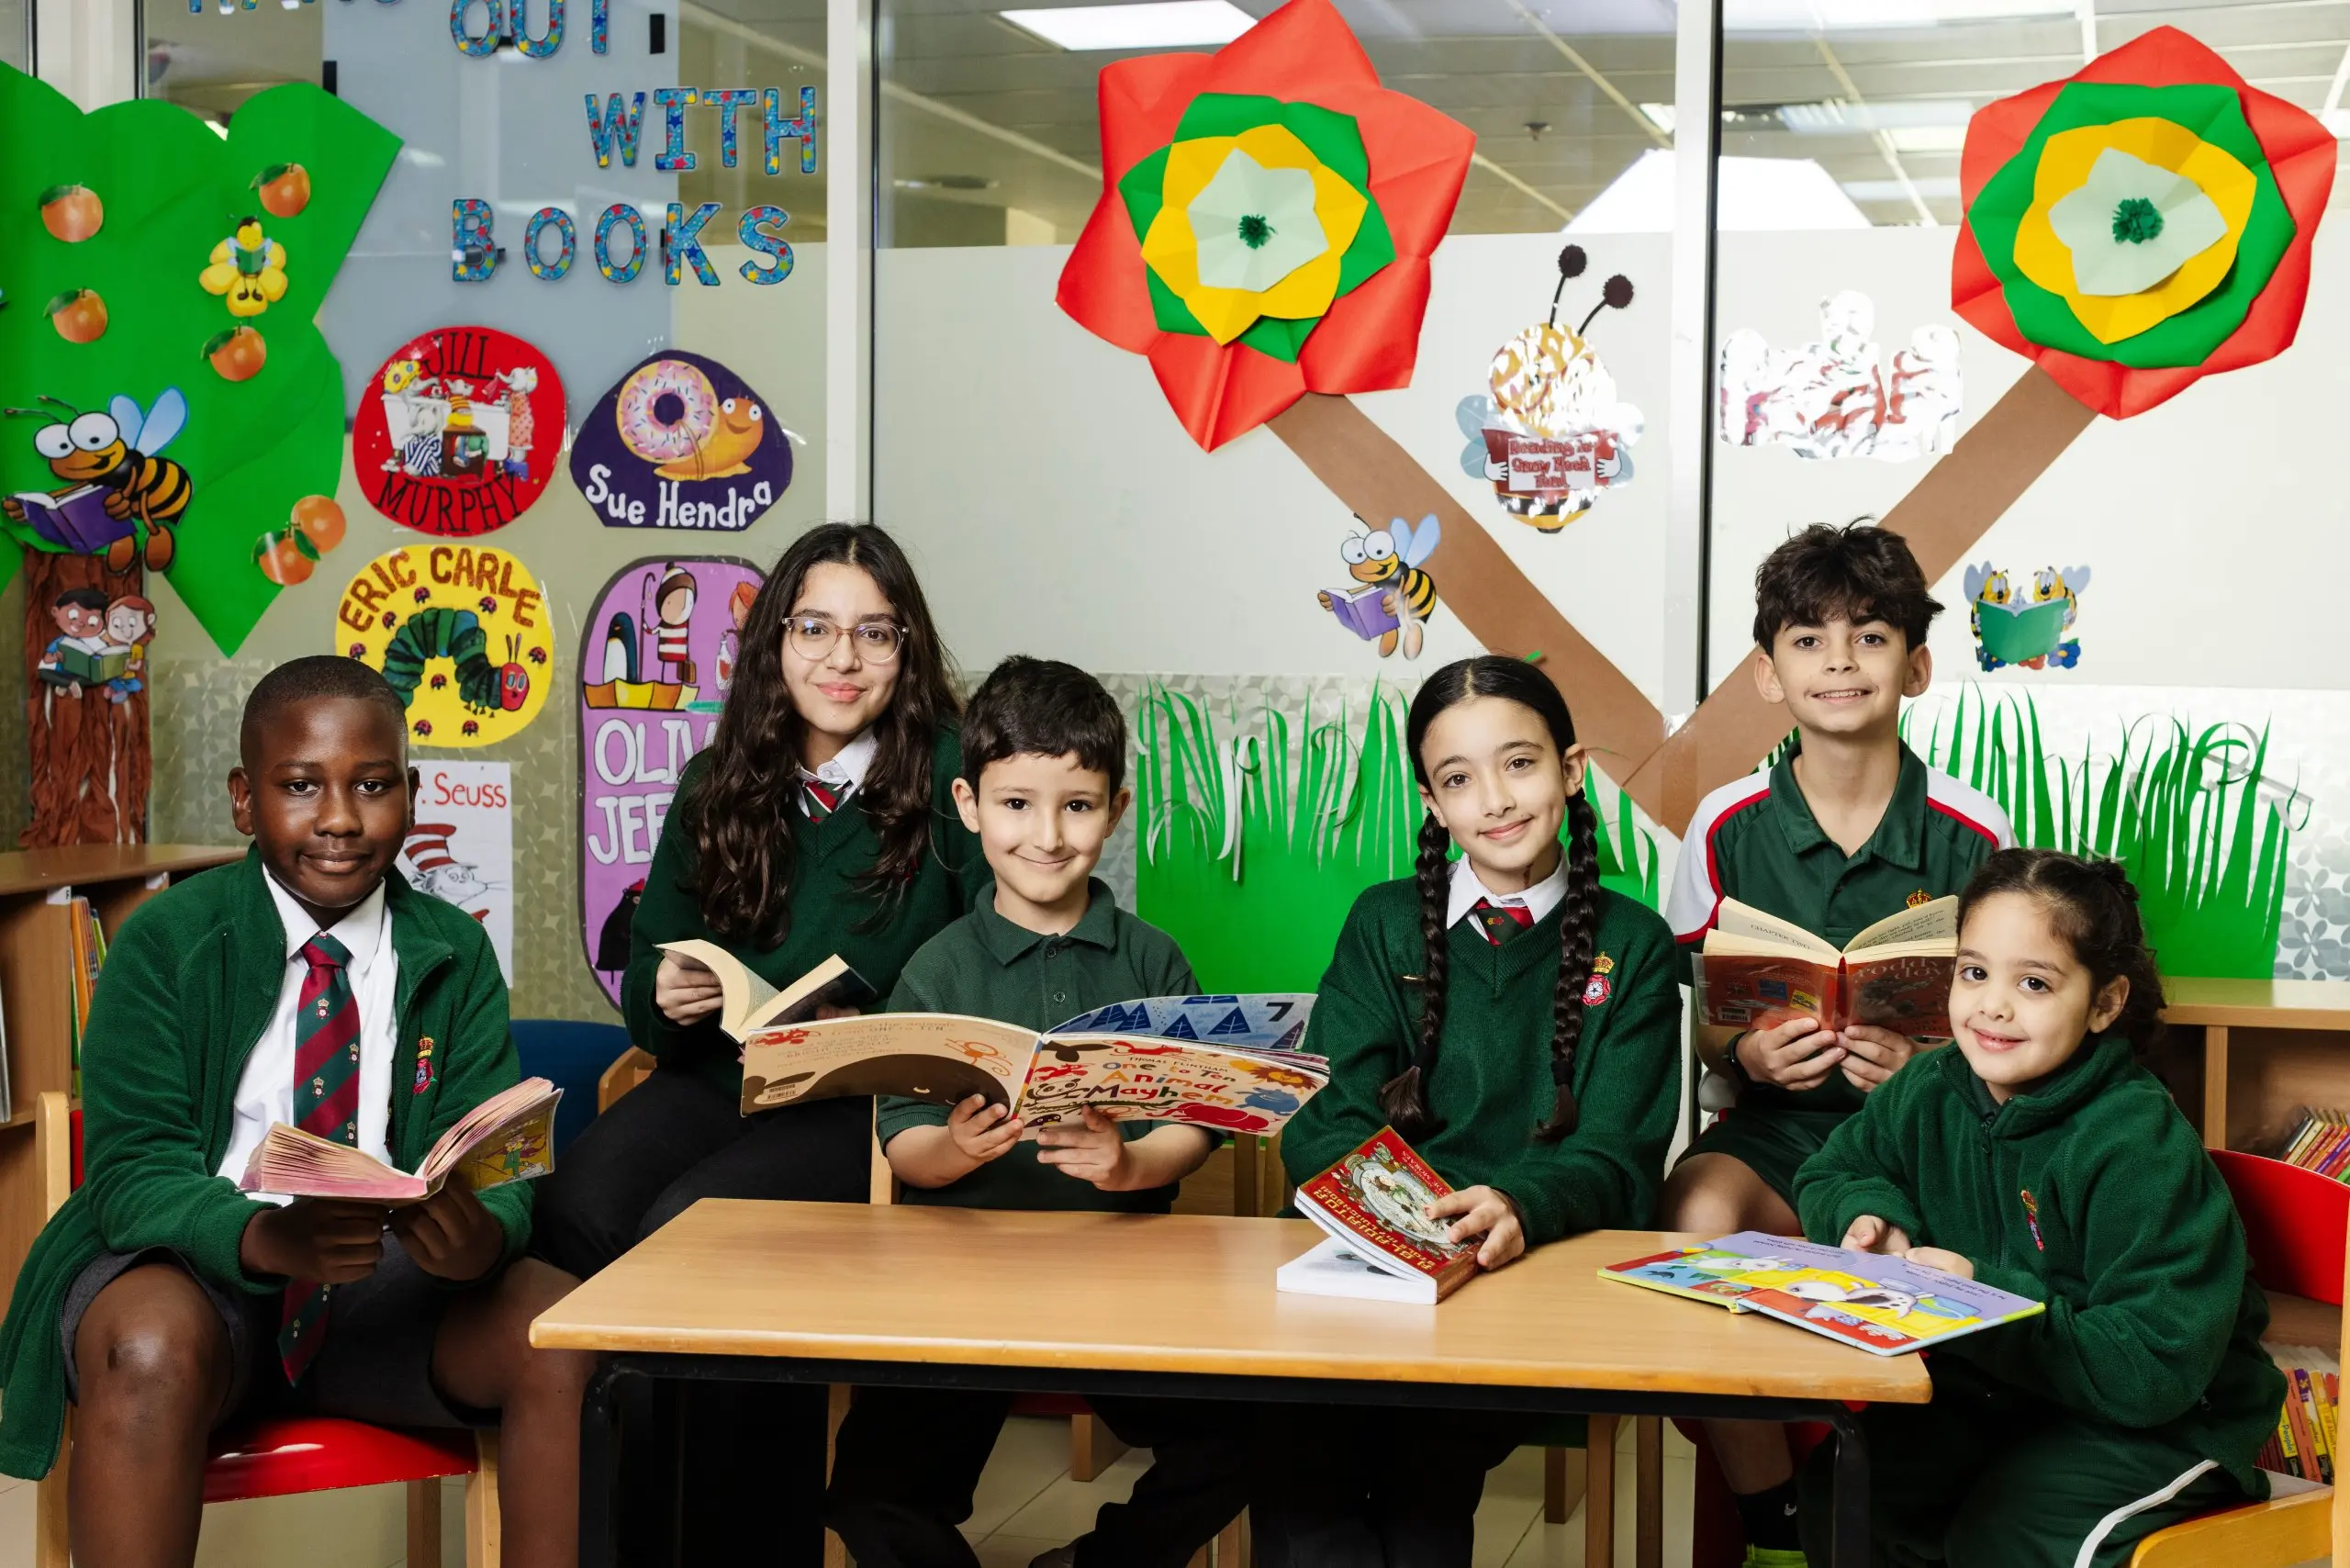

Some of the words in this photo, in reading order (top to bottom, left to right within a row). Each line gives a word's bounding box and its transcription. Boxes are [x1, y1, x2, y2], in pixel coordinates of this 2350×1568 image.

[585, 86, 817, 174] WITH
[452, 198, 795, 286] BOOKS
[420, 331, 496, 381] JILL
[376, 473, 522, 532] MURPHY
[585, 463, 646, 524] Sue
[655, 480, 772, 529] Hendra
[339, 551, 419, 633] ERIC
[430, 546, 542, 628] CARLE
[594, 718, 718, 786] OLIV
[433, 772, 507, 810] Seuss
[1266, 1002, 1294, 1022] 7
[1099, 1070, 1229, 1093] Animal
[1129, 1056, 1168, 1064] THOMAS
[1200, 1070, 1237, 1082] Ten
[1084, 1083, 1234, 1105] Mayhem
[2282, 1424, 2296, 1454] People!
